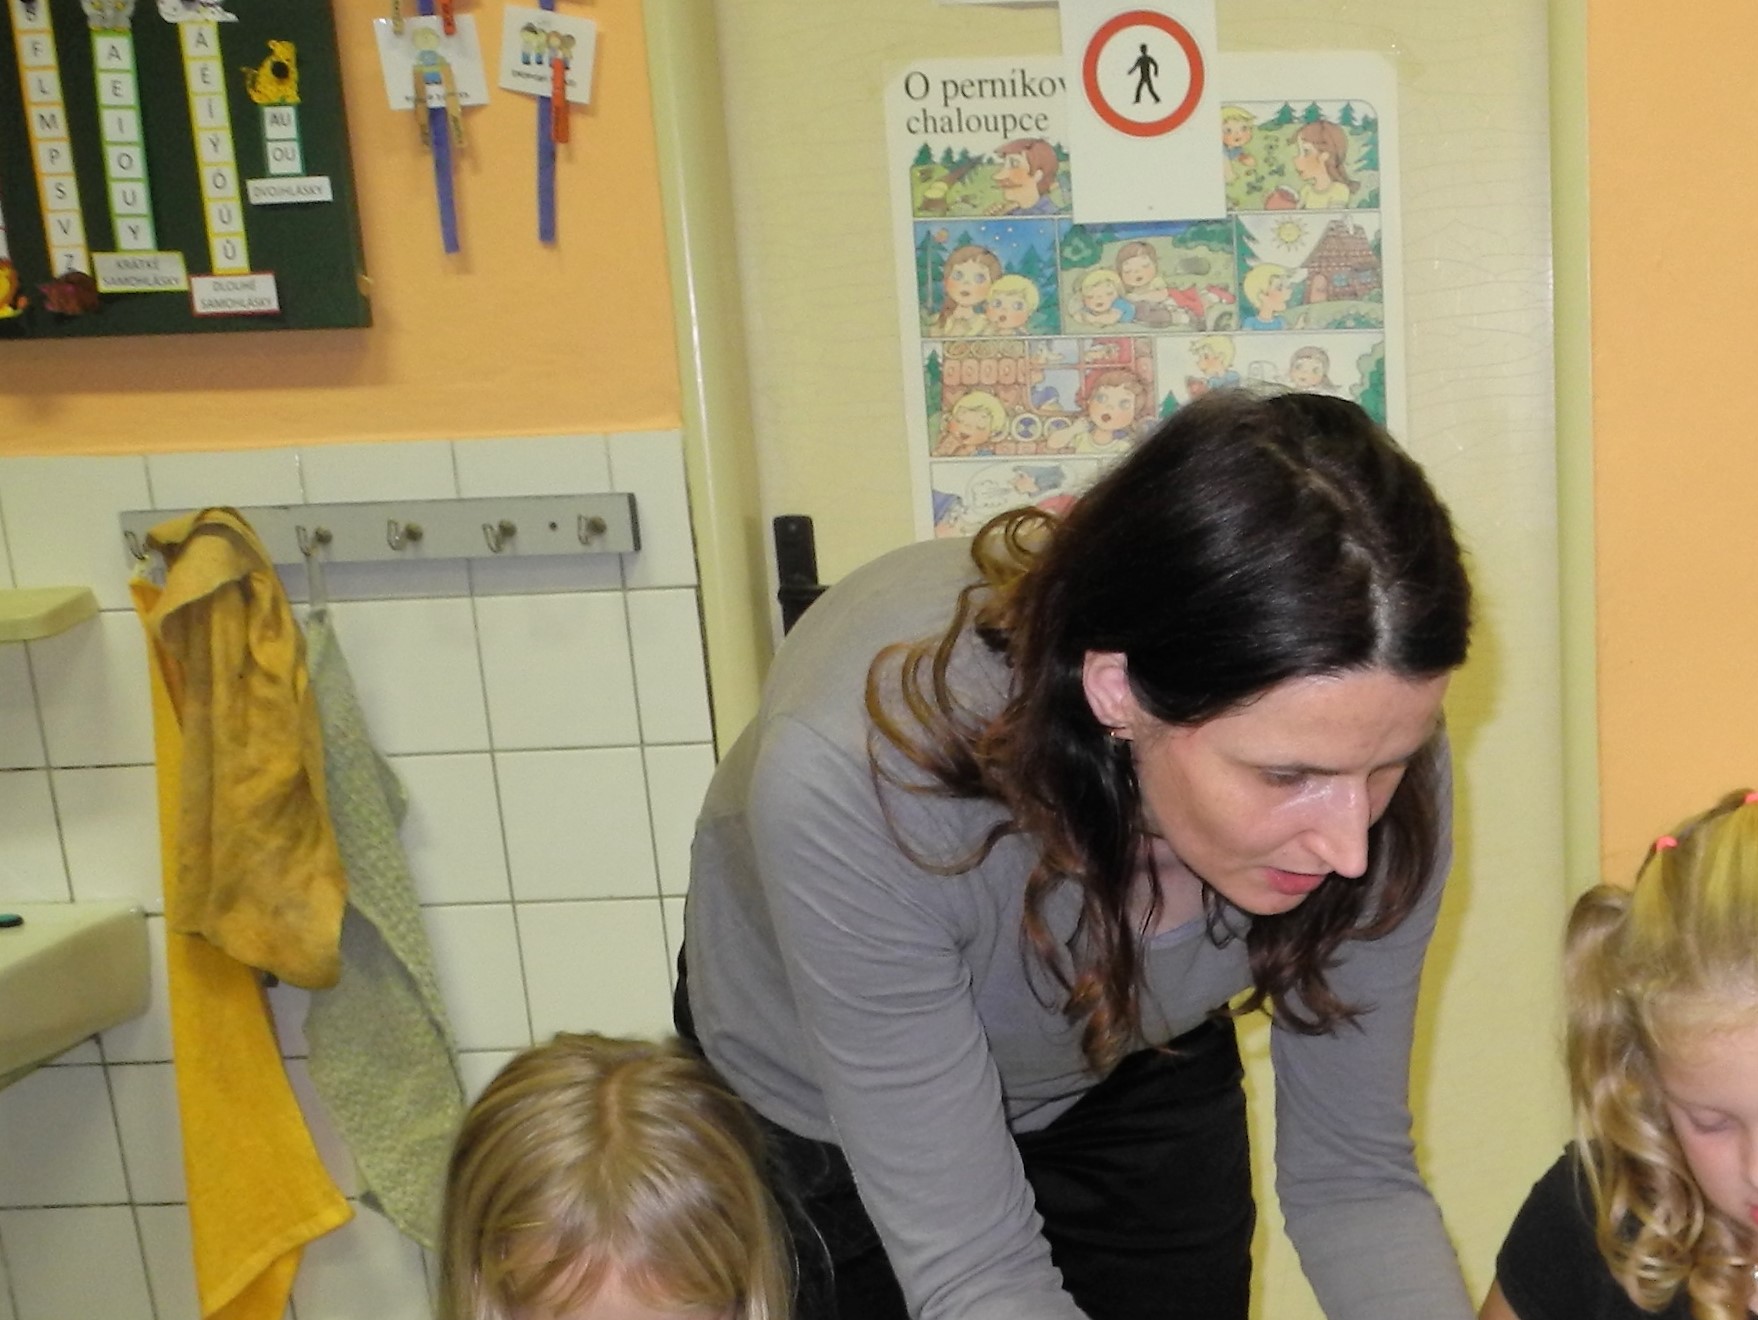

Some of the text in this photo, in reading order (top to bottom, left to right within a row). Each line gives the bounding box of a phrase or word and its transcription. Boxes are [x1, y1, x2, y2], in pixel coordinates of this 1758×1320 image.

[108, 45, 121, 61] A
[112, 82, 123, 97] E
[905, 71, 930, 101] O
[40, 114, 59, 130] M
[270, 112, 292, 127] AU
[906, 107, 1049, 139] chaloupce
[50, 149, 60, 165] P
[119, 154, 133, 170] O
[273, 147, 295, 162] OU
[55, 183, 67, 199] S
[123, 189, 136, 205] U
[57, 219, 72, 235] V
